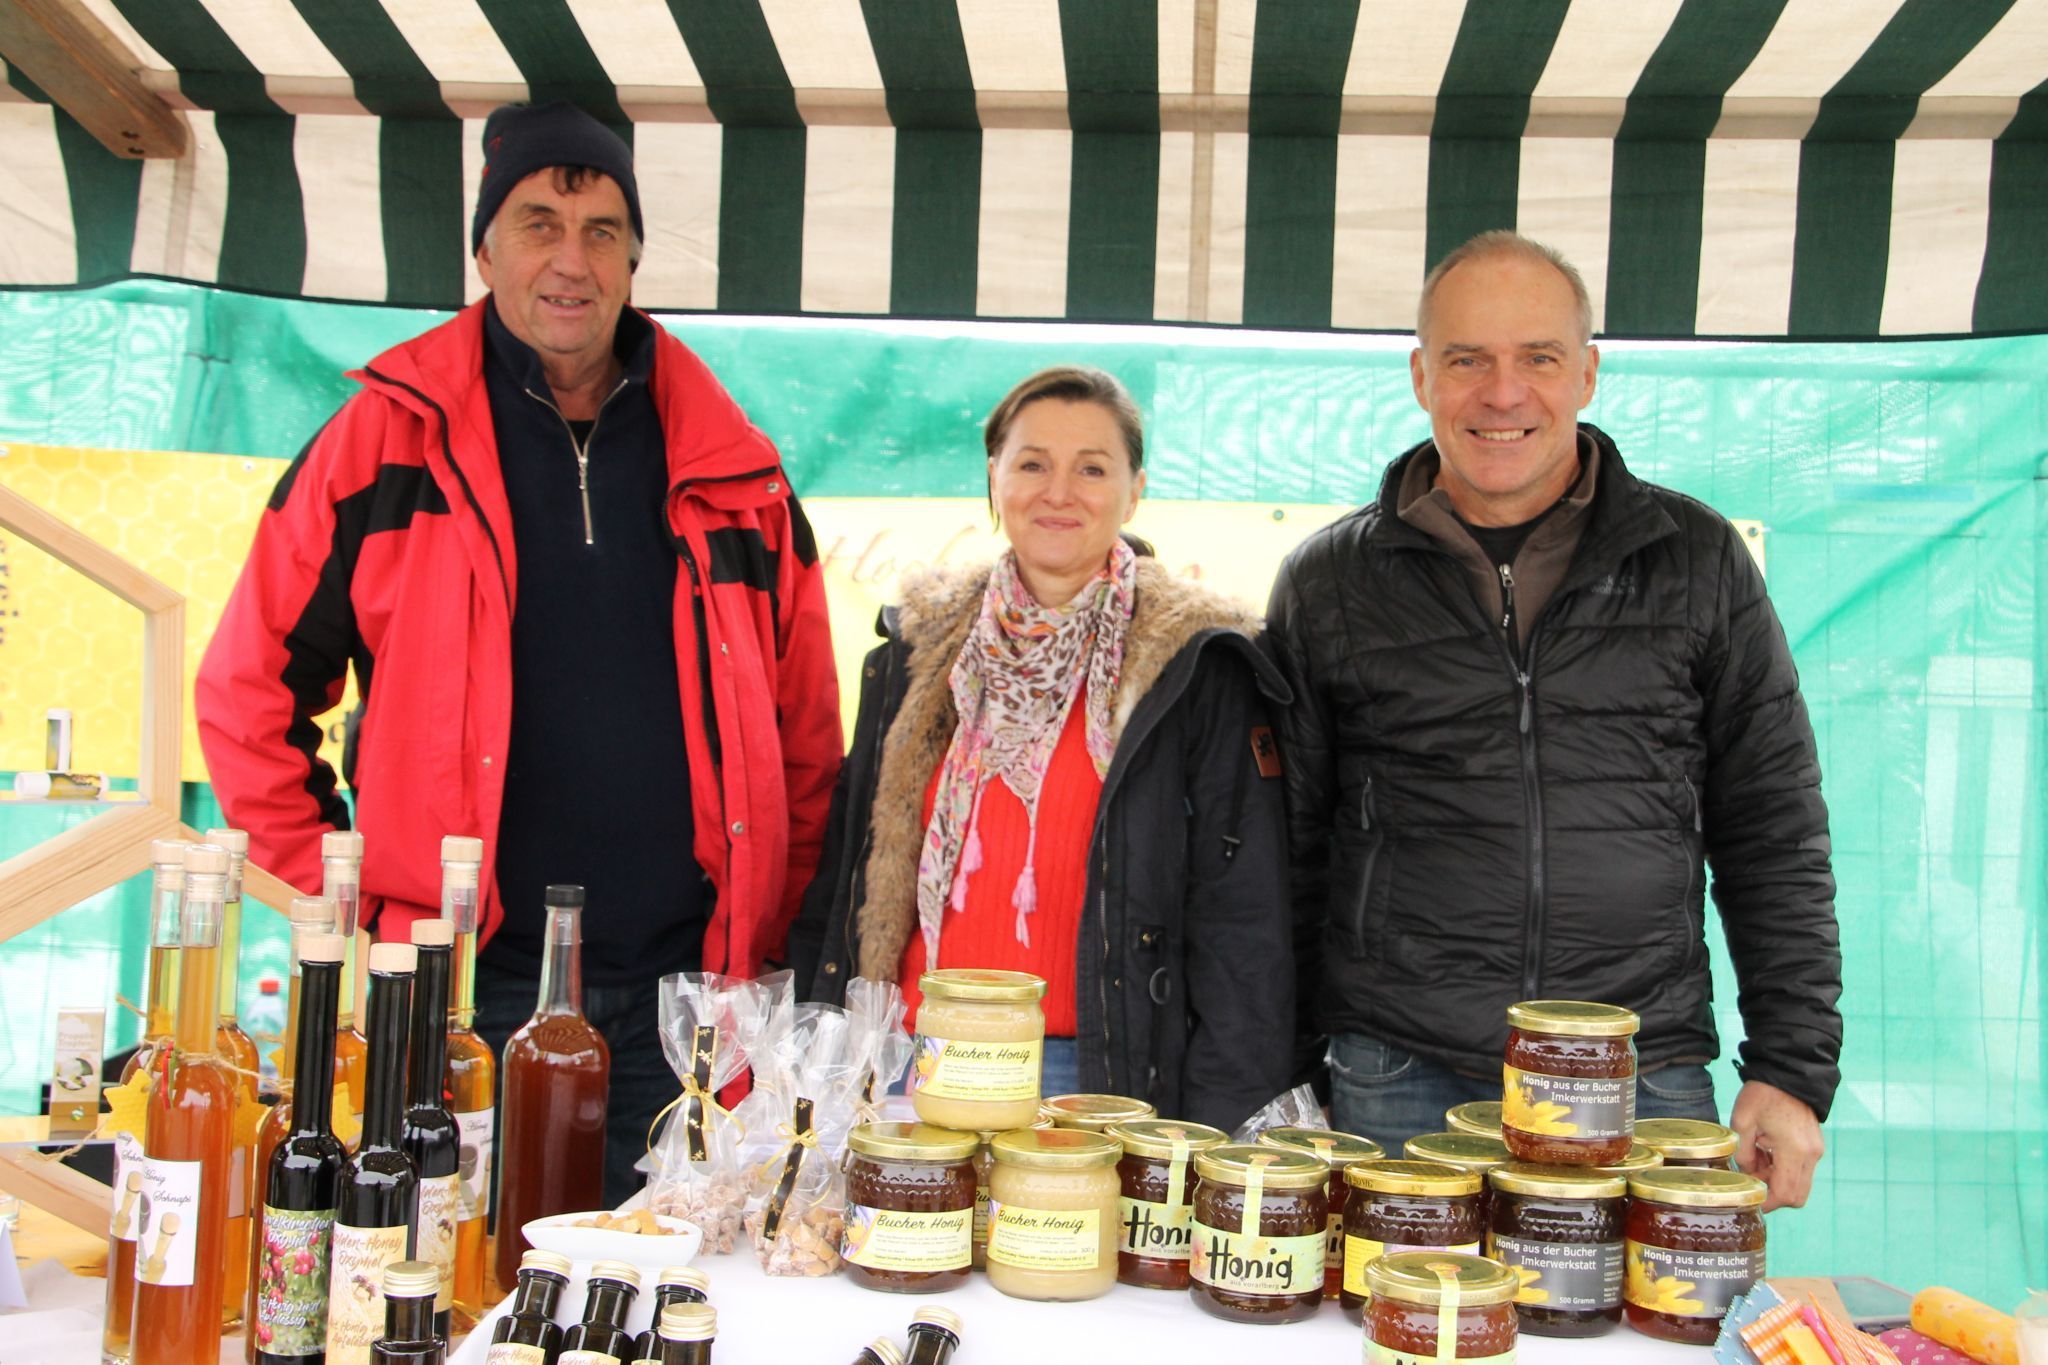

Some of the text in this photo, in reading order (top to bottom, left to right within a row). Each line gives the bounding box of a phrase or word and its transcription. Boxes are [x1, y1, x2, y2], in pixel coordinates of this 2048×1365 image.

[944, 1045, 1031, 1064] Bucher Honig
[1522, 1074, 1621, 1091] Honig aus der Bucher
[1551, 1091, 1621, 1104] Imkerwerkstatt
[1587, 1129, 1599, 1137] 500
[143, 1166, 166, 1187] Honig
[152, 1190, 192, 1207] Schnaps
[876, 1214, 926, 1230] Bucher
[930, 1217, 964, 1232] Honig
[998, 1209, 1038, 1228] Bucher
[1043, 1216, 1085, 1235] Honig
[1123, 1205, 1192, 1249] Honi
[1496, 1237, 1597, 1257] Honig aus der Bucher
[338, 1250, 386, 1272] Oxymel
[1205, 1235, 1293, 1290] Honig
[1521, 1255, 1597, 1271] Imkerwerkstatt
[1643, 1247, 1672, 1265] Honig
[1675, 1255, 1694, 1265] aus
[1697, 1255, 1714, 1266] der
[1717, 1256, 1749, 1266] Bucher
[1673, 1266, 1749, 1280] Imkerwerkstatt
[1559, 1296, 1596, 1304] 500 Gramm
[1714, 1306, 1727, 1314] 500
